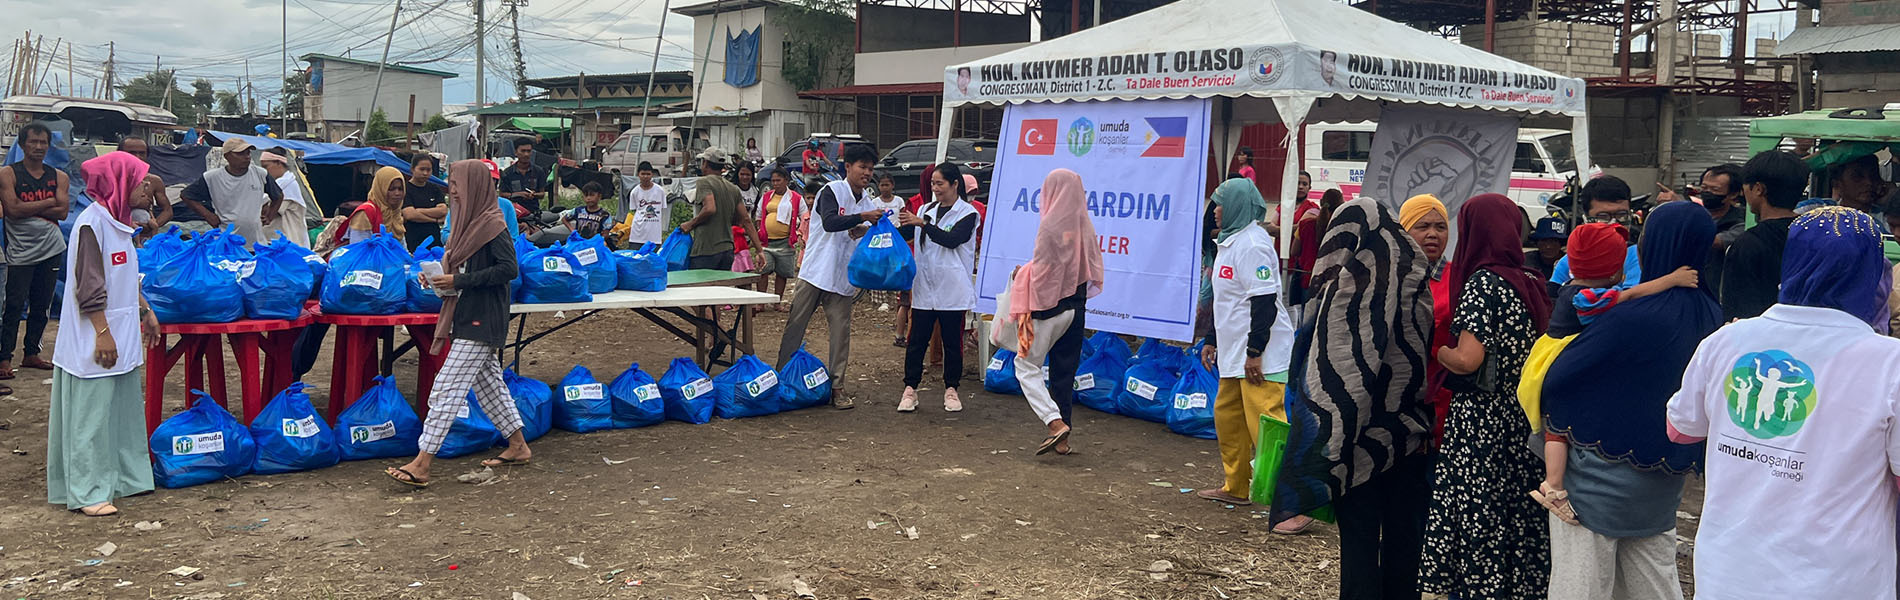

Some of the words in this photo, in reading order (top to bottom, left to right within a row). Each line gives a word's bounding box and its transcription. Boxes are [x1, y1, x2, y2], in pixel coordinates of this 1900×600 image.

[981, 63, 1018, 82] HON.
[1021, 57, 1093, 81] KHYMER
[1097, 53, 1149, 76] ADAN
[1155, 52, 1168, 73] T.
[1173, 47, 1244, 73] OLASO
[979, 82, 1049, 96] CONGRESSMAN,
[1050, 80, 1083, 93] District
[1085, 80, 1090, 92] 1
[1097, 78, 1116, 91] Z.C.
[1126, 78, 1138, 90] Ta
[1139, 77, 1161, 89] Dale
[1163, 76, 1190, 88] Buen
[1192, 74, 1236, 88] Servicio!
[1348, 75, 1418, 97] CONGRESSMAN,
[1419, 82, 1448, 97] District
[1481, 88, 1490, 100] Ta
[1491, 89, 1506, 101] Dale
[1100, 119, 1130, 132] umuda
[1012, 187, 1041, 213] AC
[1085, 190, 1171, 221] ARDIM
[1096, 234, 1130, 255] LER
[198, 433, 222, 442] umuda
